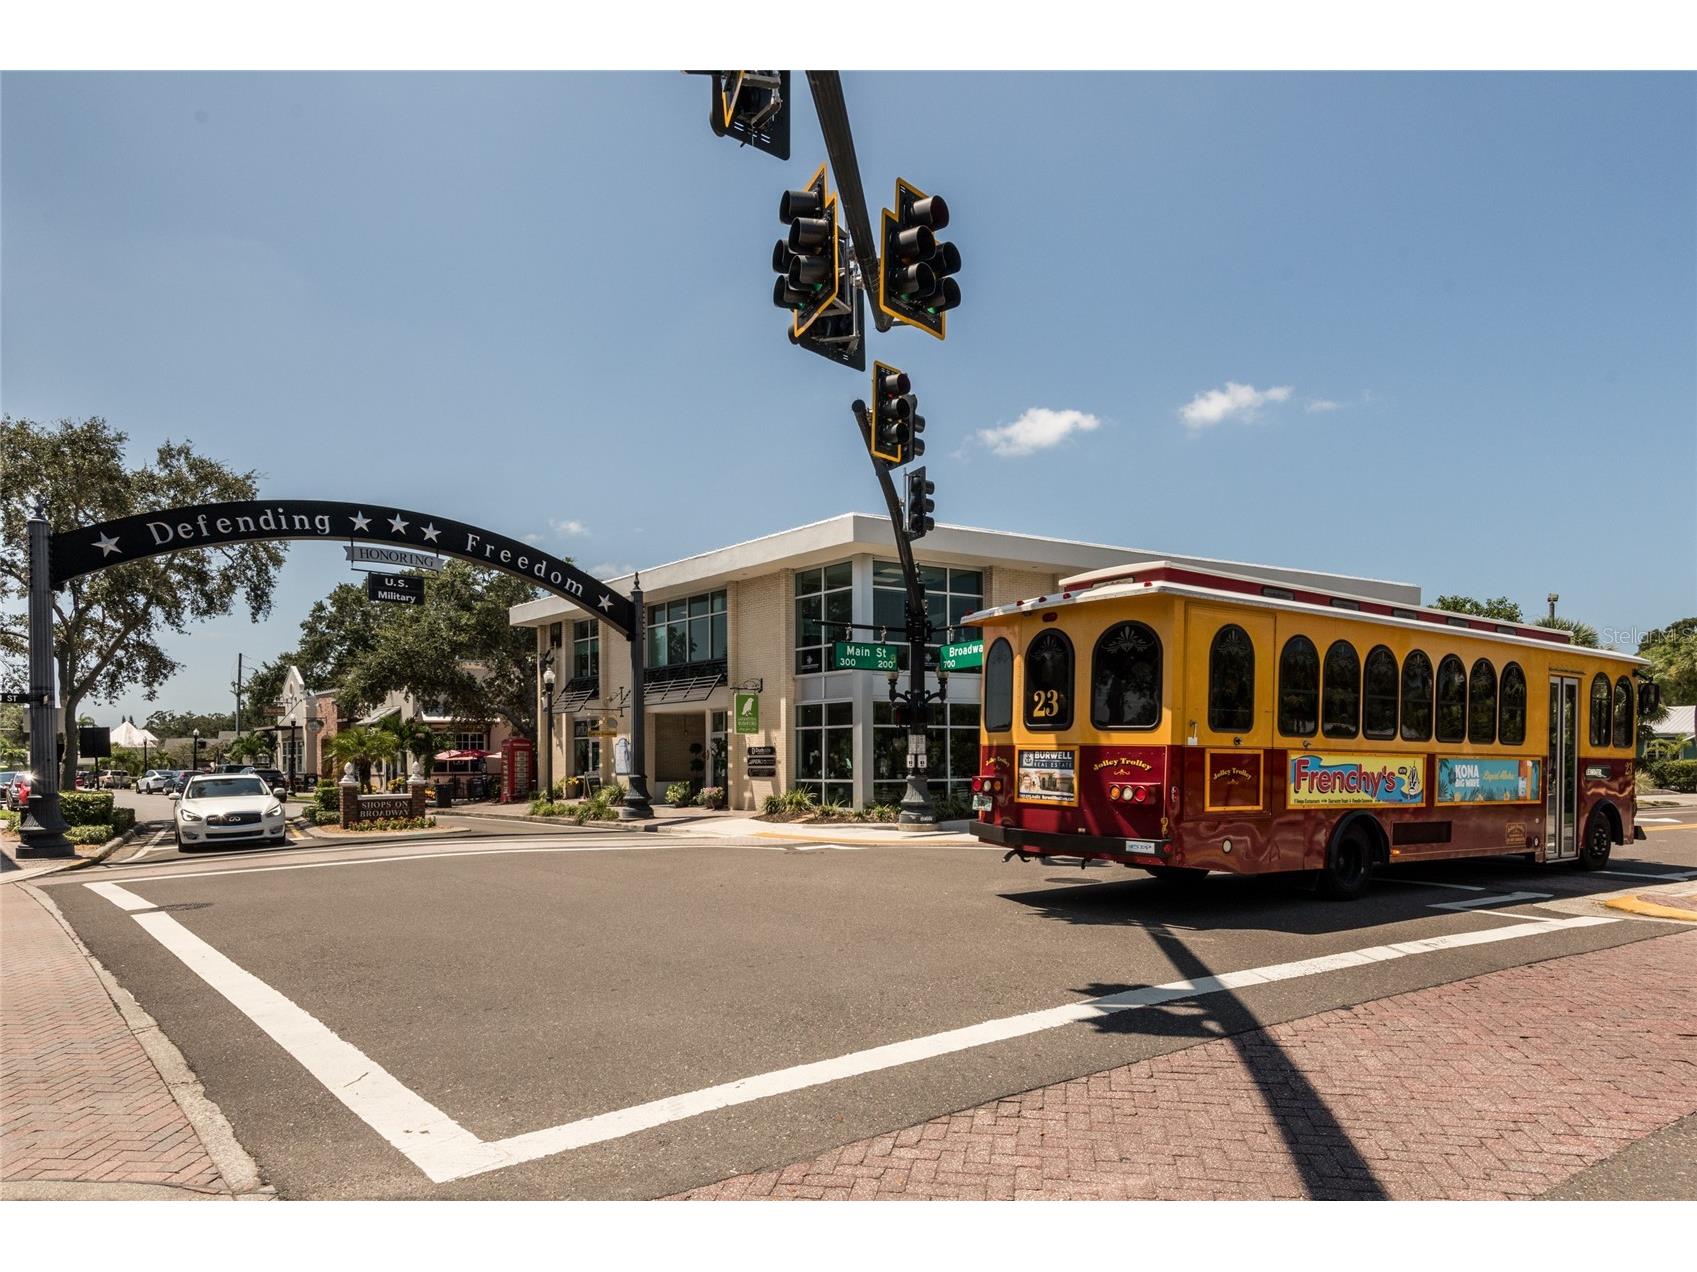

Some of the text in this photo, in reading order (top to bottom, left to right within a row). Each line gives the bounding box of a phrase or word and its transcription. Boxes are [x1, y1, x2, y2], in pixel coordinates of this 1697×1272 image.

[146, 507, 584, 597] Defending Freedom
[360, 548, 434, 567] HONORING
[385, 578, 409, 588] U.S.
[378, 590, 416, 604] Military
[846, 645, 887, 658] Main St
[949, 643, 984, 657] Broadwa
[840, 657, 856, 667] 300
[877, 660, 894, 669] 200
[7, 695, 18, 703] ST
[1033, 689, 1059, 717] 23
[1034, 751, 1073, 760] BURWELL
[1092, 757, 1152, 771] Jolley Trolley
[1232, 768, 1251, 780] Trolley
[1294, 757, 1397, 799] Frenchy's
[1454, 764, 1480, 779] KONA
[361, 800, 409, 809] SHOPS ON
[360, 809, 409, 818] BROADWAY
